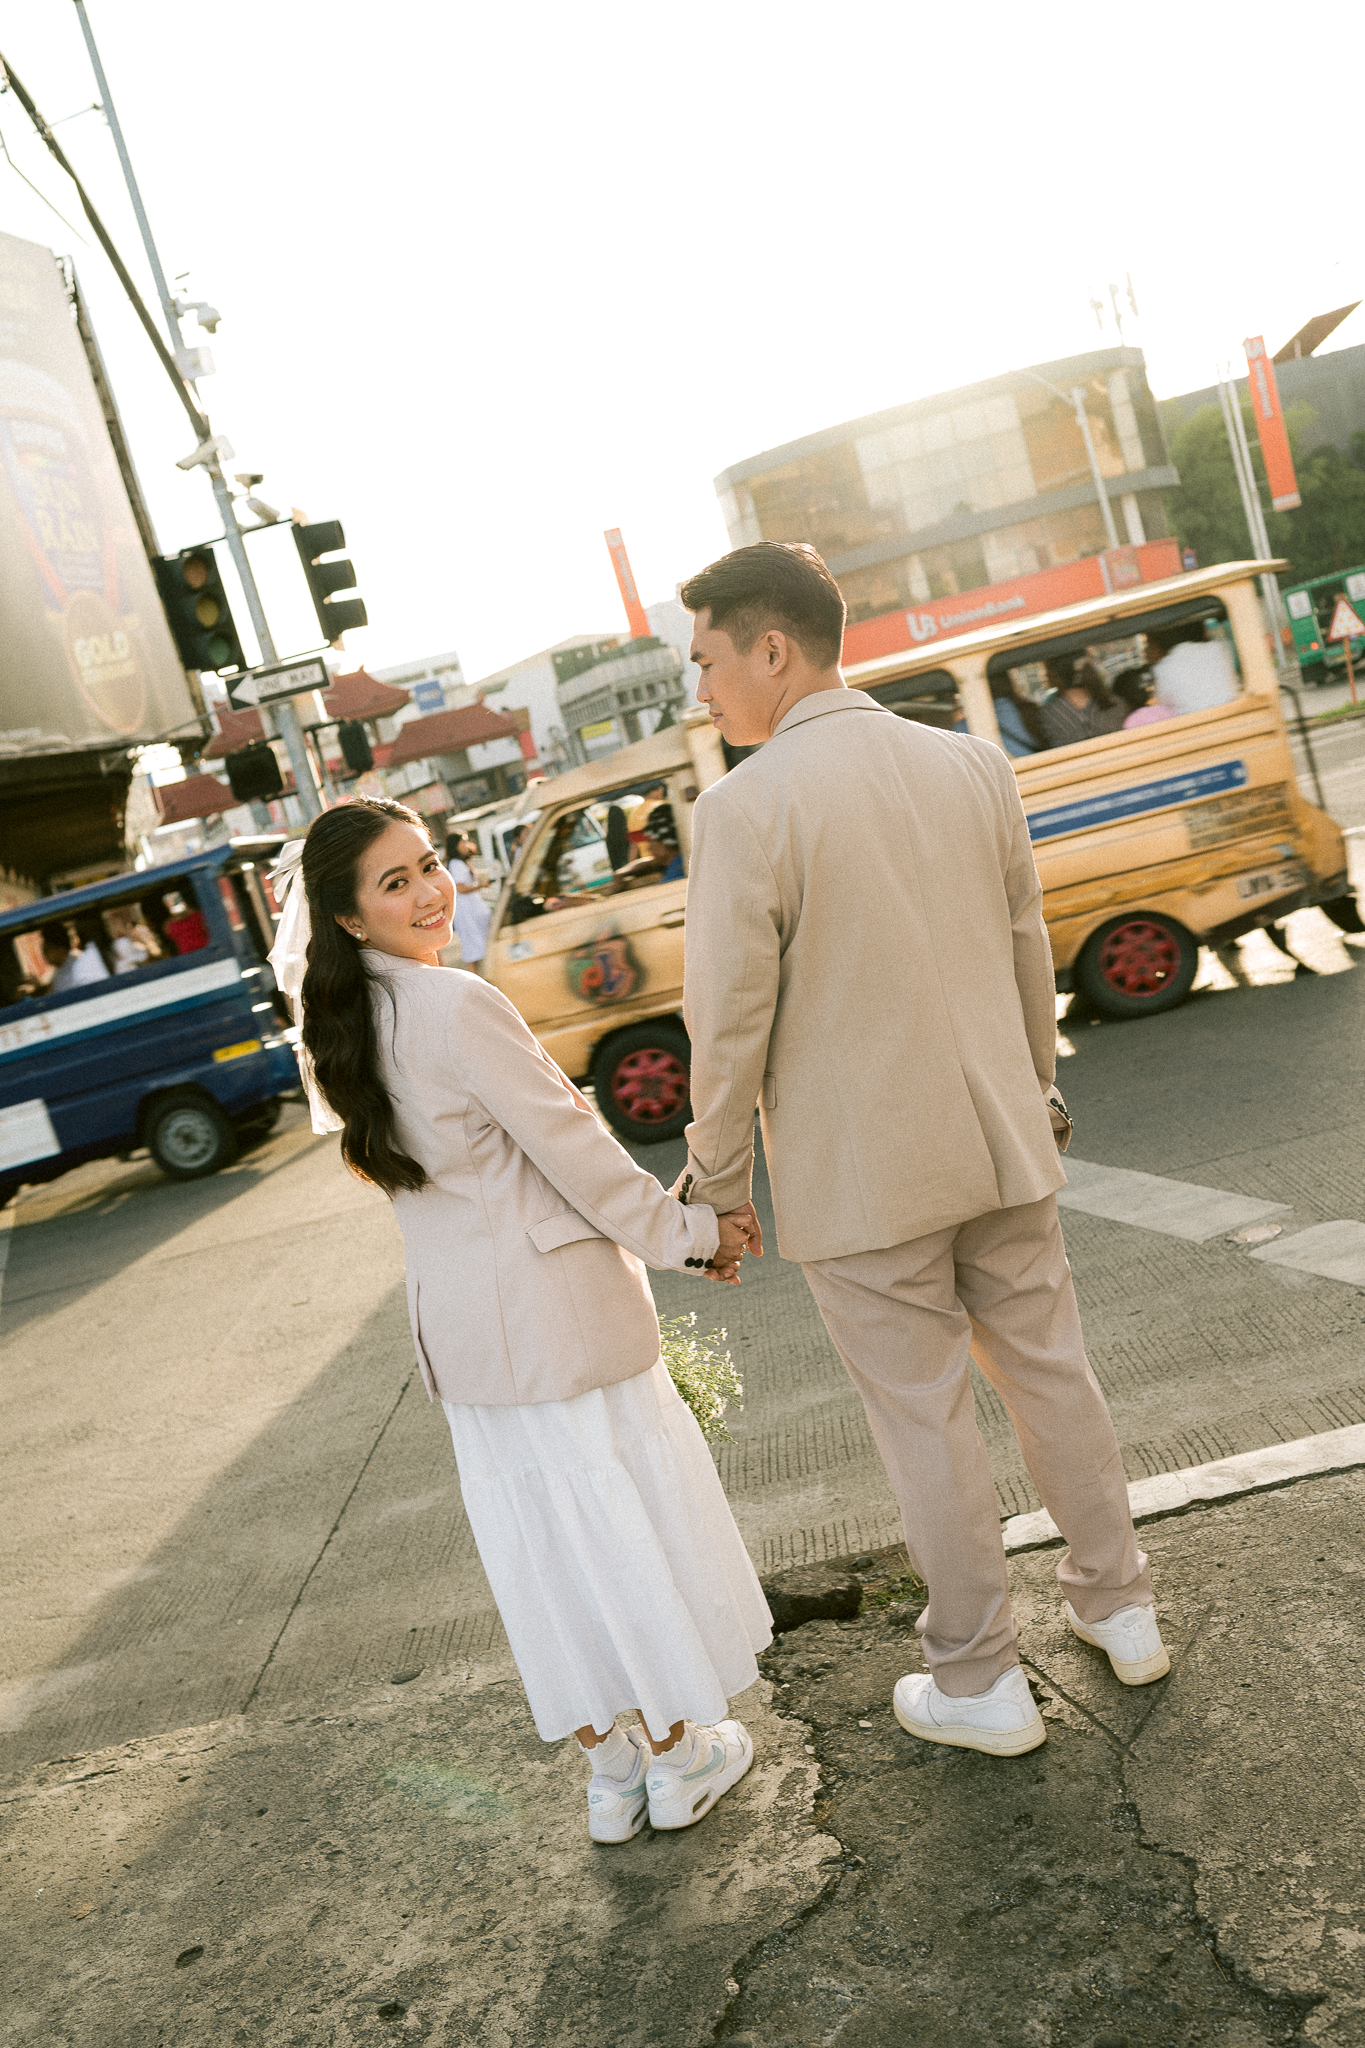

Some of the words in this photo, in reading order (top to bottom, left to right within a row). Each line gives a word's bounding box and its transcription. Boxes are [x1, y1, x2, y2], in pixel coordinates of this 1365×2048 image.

[74, 629, 130, 668] GOLD
[256, 677, 281, 694] ONE
[289, 668, 315, 685] WAY
